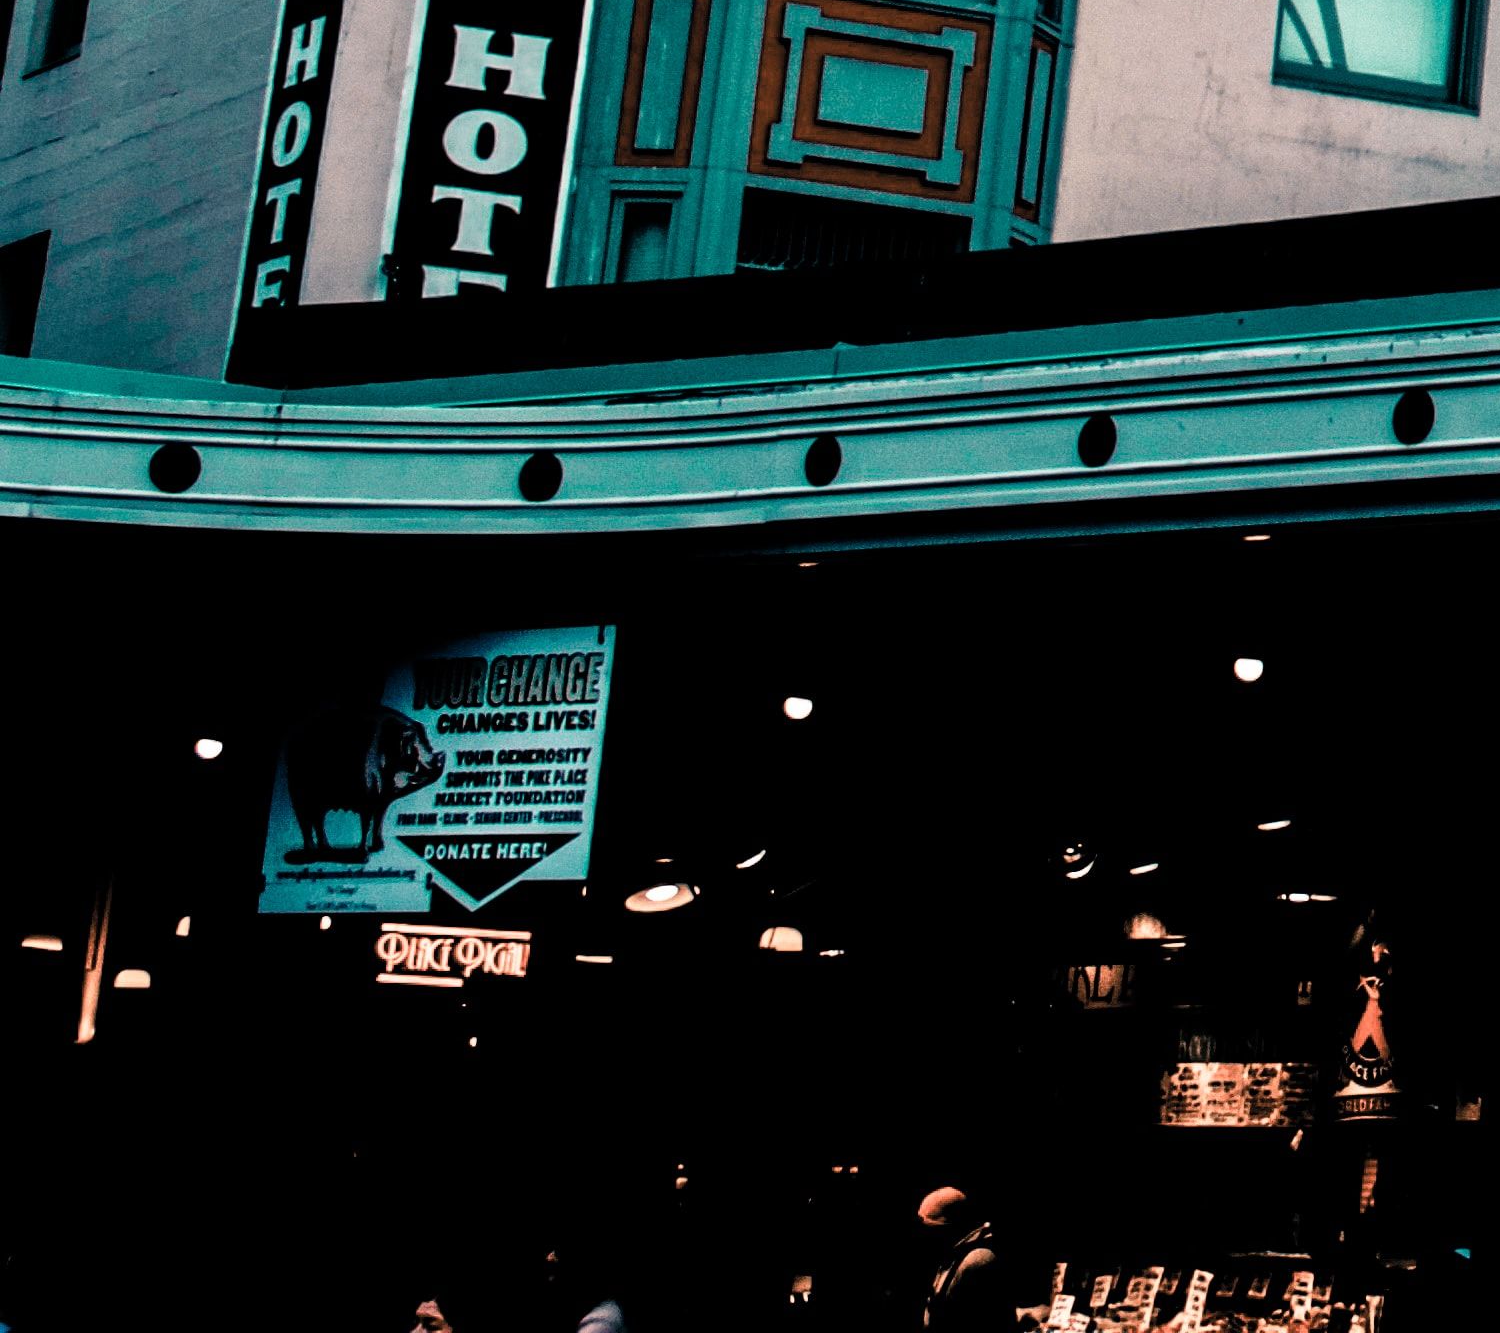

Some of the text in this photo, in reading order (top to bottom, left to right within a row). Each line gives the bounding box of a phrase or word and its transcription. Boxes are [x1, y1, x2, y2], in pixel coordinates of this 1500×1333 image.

[414, 652, 605, 709] OUR CHANGE
[437, 709, 597, 734] CHANGES LIVES!
[456, 747, 592, 765] YOUR GENEROSITY
[445, 768, 588, 788] SUPPORTS THE PIKE PLACE
[434, 789, 587, 806] MARKET FOUNDATION
[423, 842, 548, 861] DONATE HERE!
